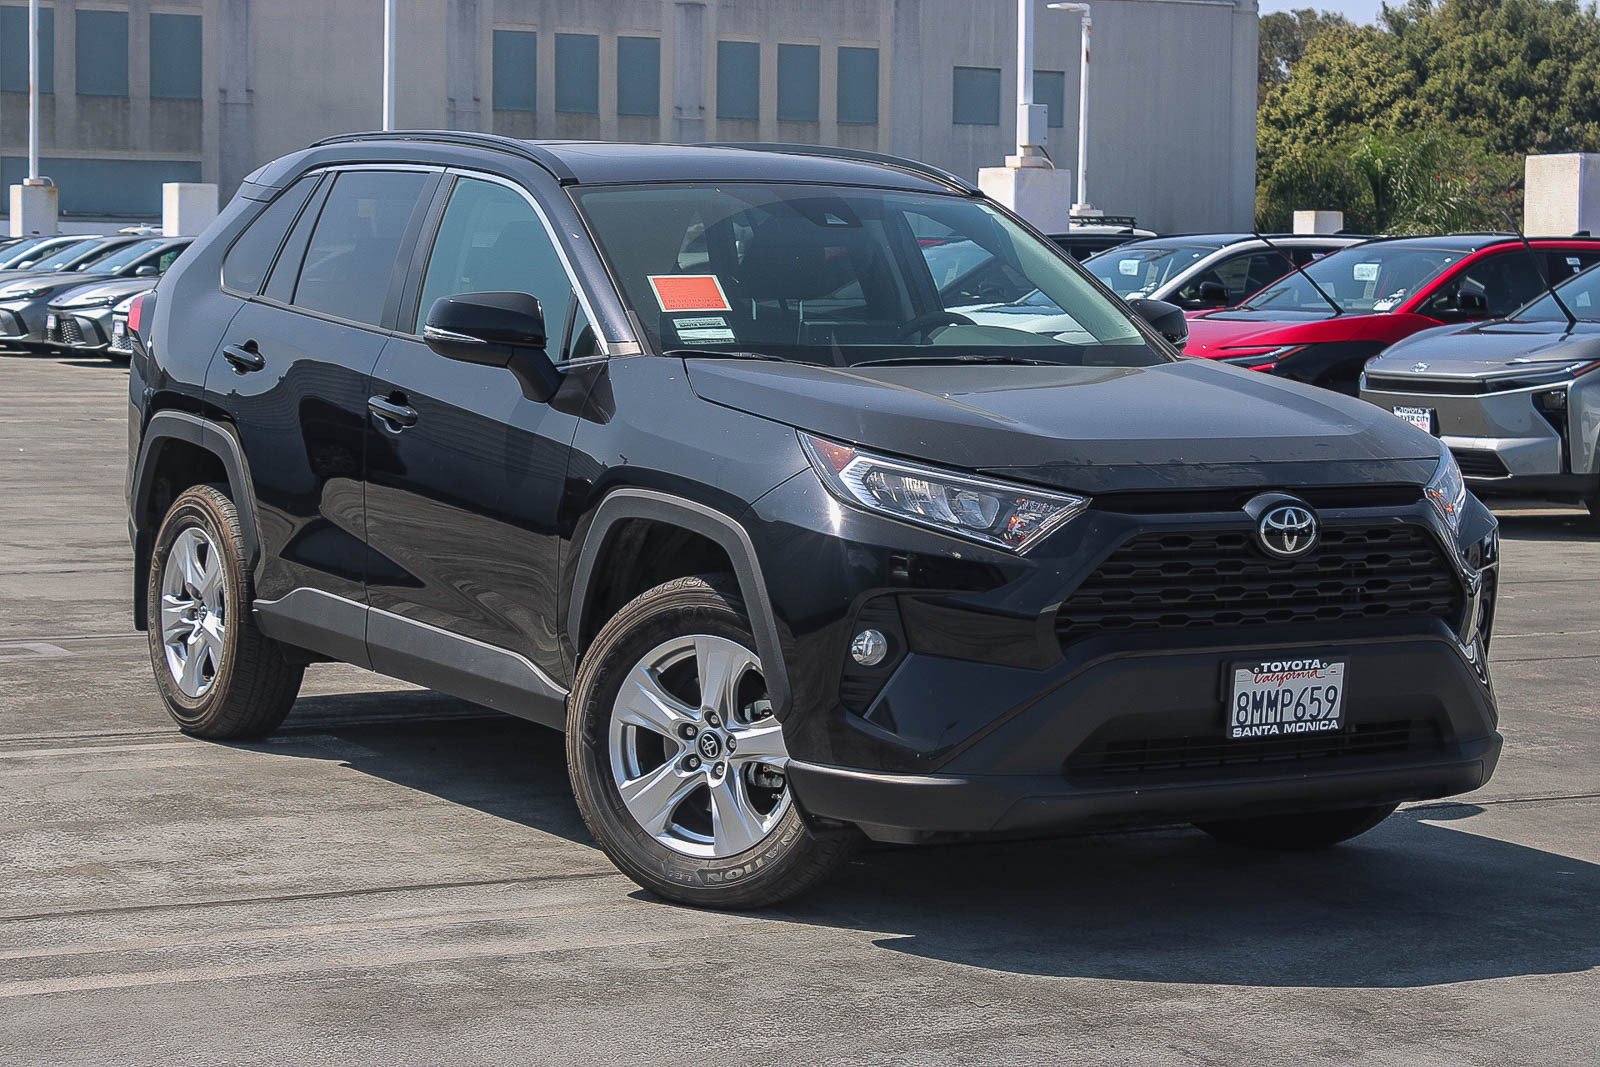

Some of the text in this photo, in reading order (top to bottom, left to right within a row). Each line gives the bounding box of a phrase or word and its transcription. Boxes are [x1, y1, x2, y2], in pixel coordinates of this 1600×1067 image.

[1416, 415, 1429, 423] CITY
[1261, 659, 1320, 672] TOYOTA
[1253, 669, 1325, 687] California
[1235, 685, 1338, 725] 8MMP659
[1232, 720, 1338, 738] SANTA MONICA
